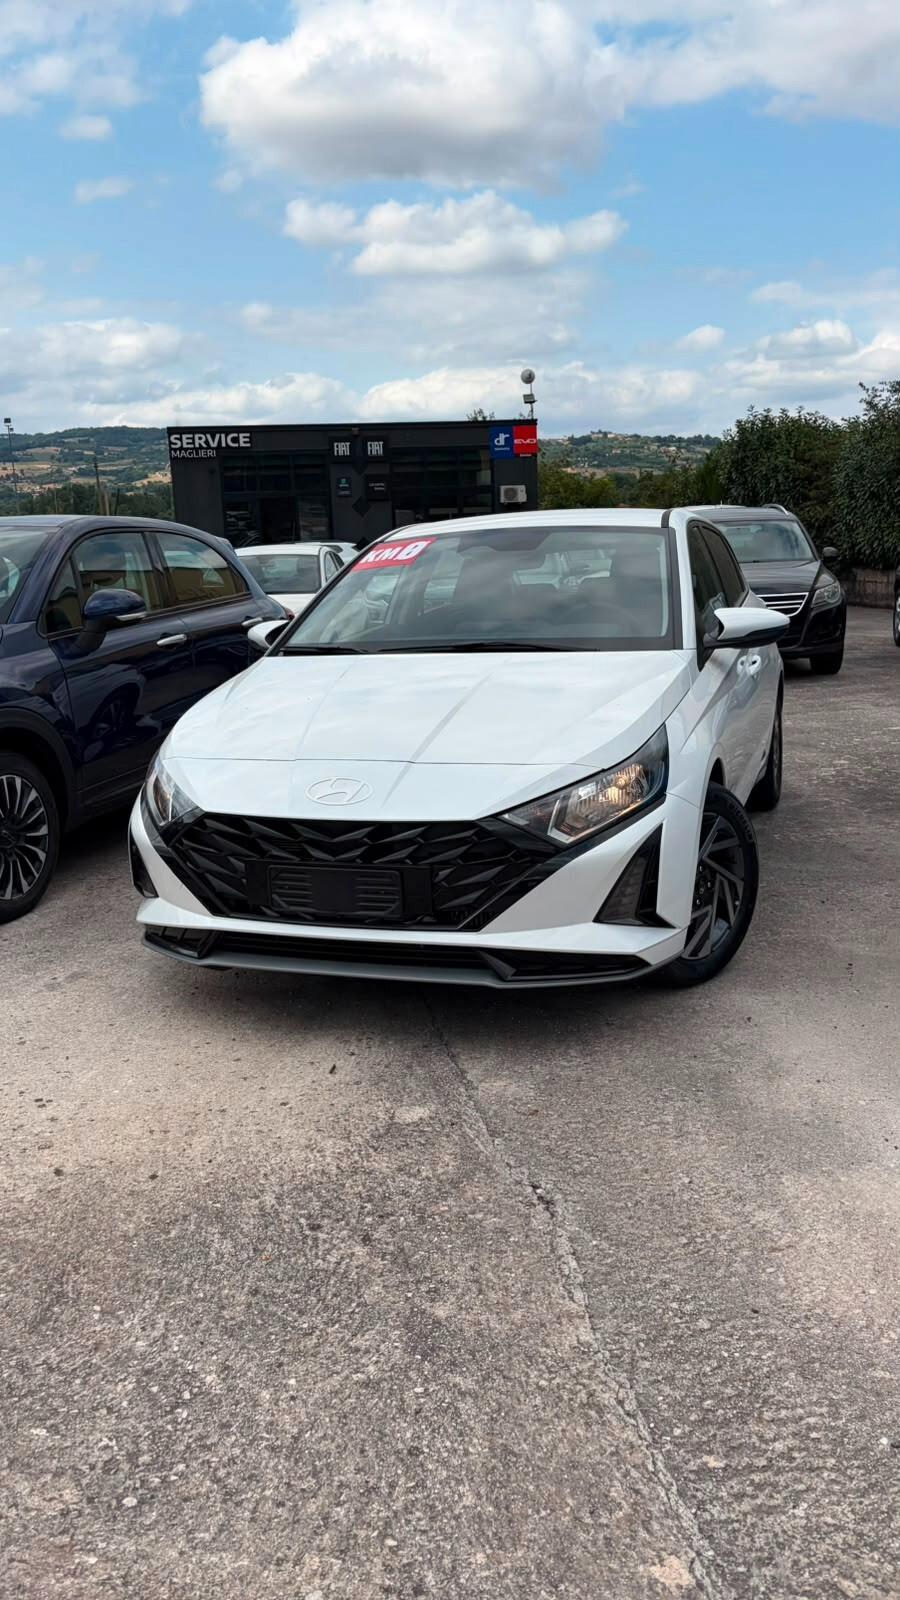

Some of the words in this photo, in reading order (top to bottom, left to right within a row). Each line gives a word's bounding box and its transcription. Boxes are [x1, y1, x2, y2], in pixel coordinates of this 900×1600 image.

[170, 433, 251, 449] SERVICE
[494, 432, 510, 446] dr
[171, 449, 216, 458] MAGLIERI
[333, 442, 351, 456] FIAT
[367, 441, 384, 456] FIAT
